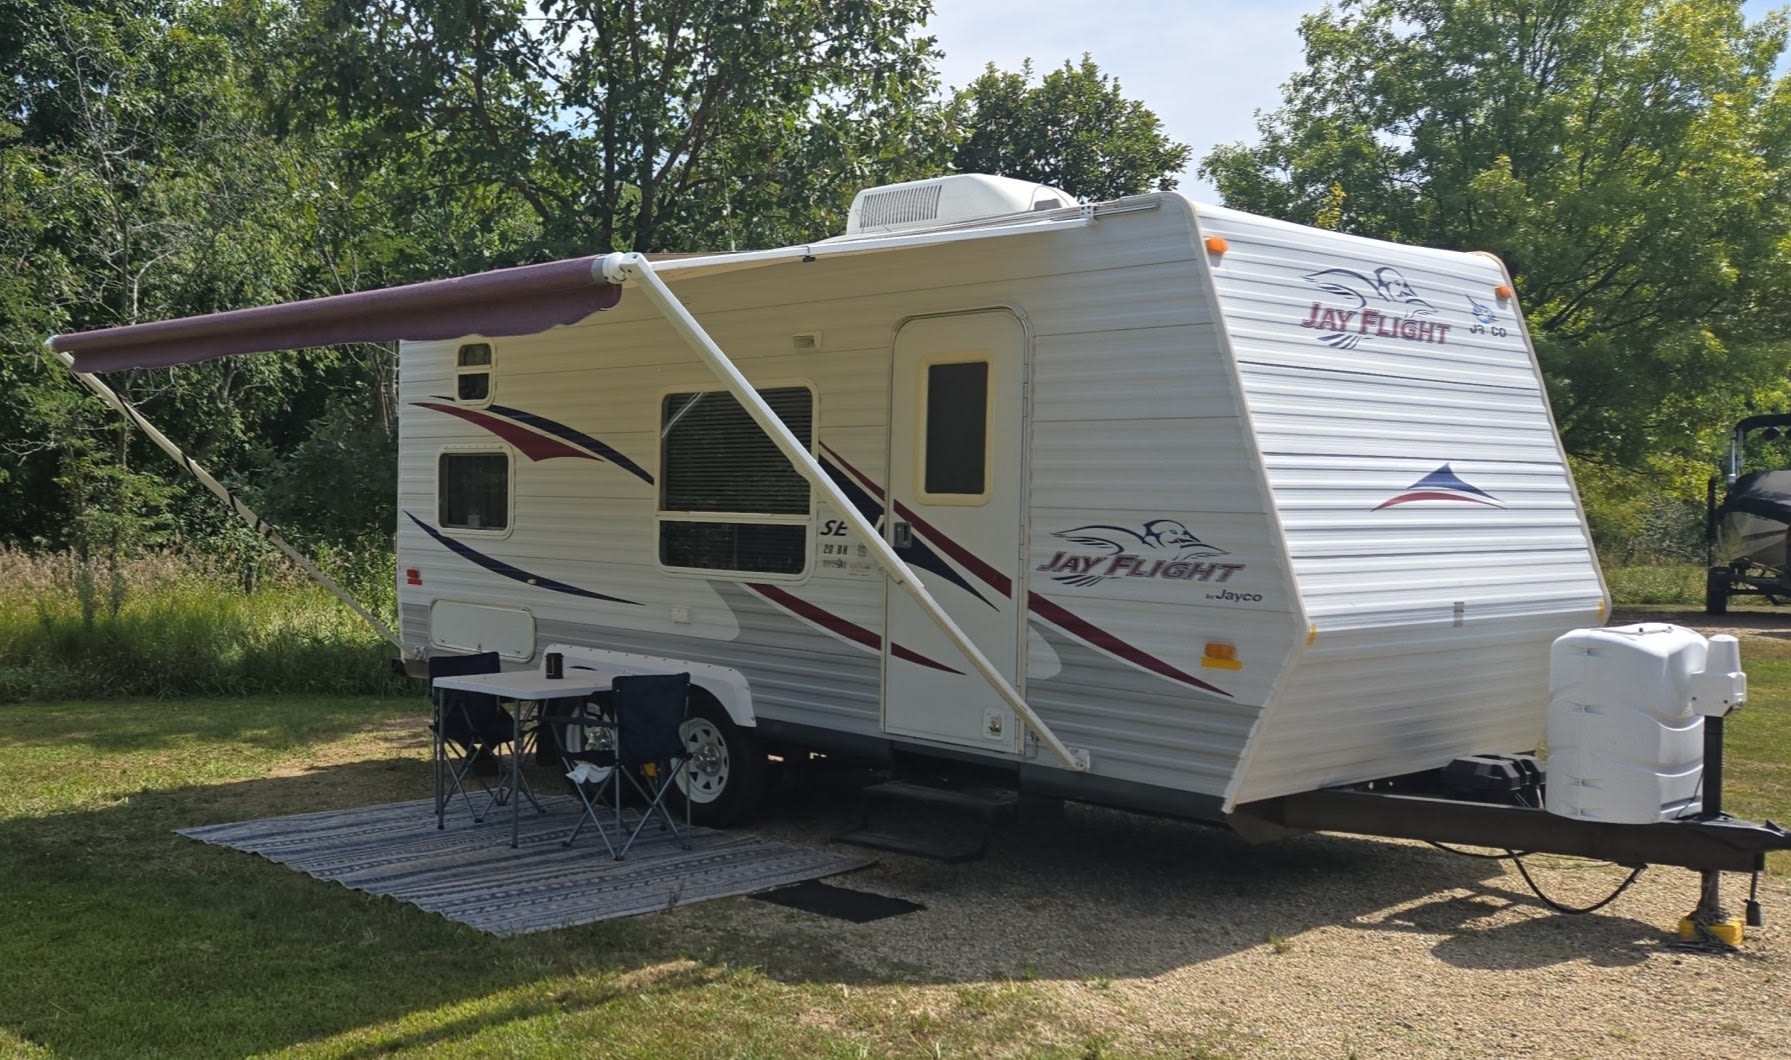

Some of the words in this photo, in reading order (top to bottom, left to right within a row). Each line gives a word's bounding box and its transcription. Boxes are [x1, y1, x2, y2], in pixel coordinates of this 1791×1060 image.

[1302, 302, 1357, 332] JAY
[1358, 308, 1452, 344] FLIGHT
[1036, 551, 1106, 574] JAY
[1104, 554, 1246, 583] FLIGHT
[1215, 588, 1263, 603] Jayco
